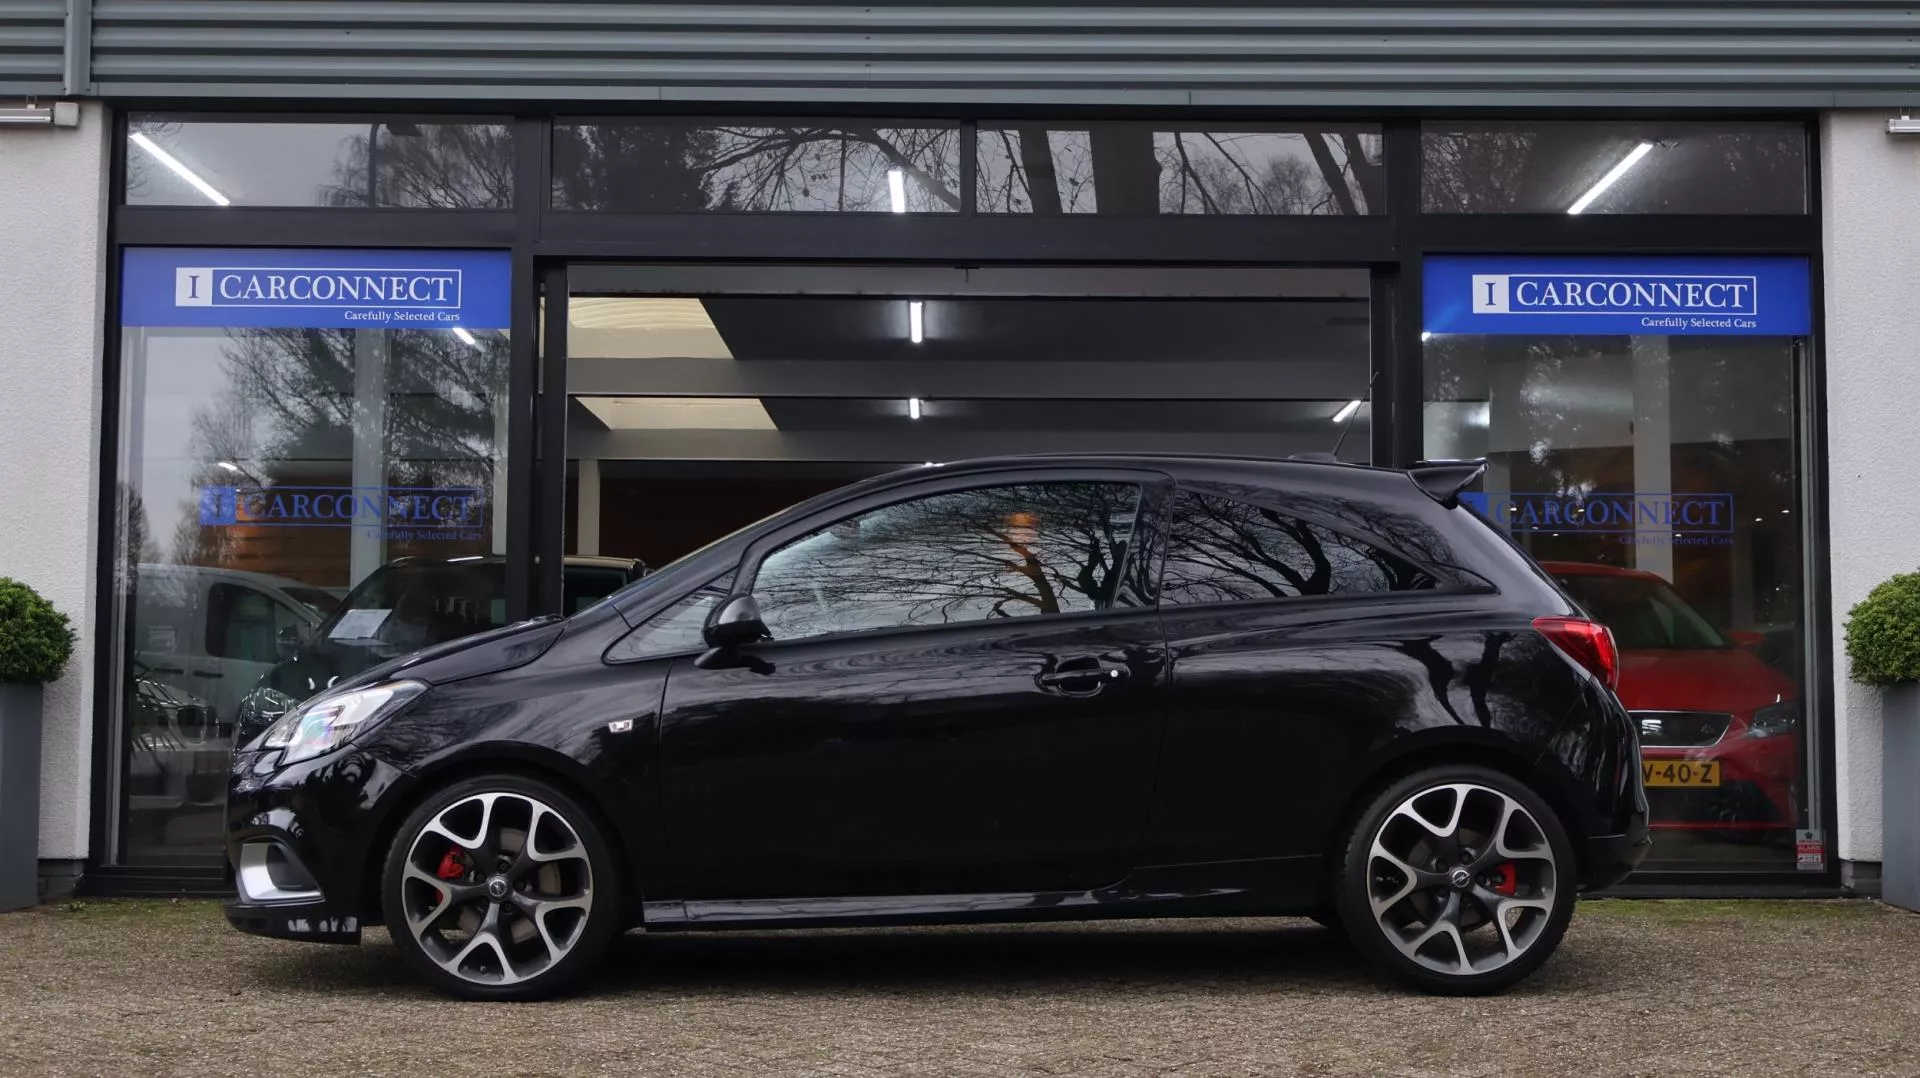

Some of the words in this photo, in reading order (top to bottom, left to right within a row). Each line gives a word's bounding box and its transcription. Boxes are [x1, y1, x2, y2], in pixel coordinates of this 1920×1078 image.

[219, 274, 453, 301] CARCONNECT
[1516, 281, 1748, 308] CARCONNECT
[344, 310, 391, 323] Carefully
[394, 311, 435, 321] Selected
[437, 312, 460, 321] Cars
[1641, 317, 1688, 330] Carefully
[1690, 317, 1731, 328] Selected
[1733, 318, 1757, 328] Cars
[247, 493, 470, 521] CARCONNECT
[1495, 500, 1725, 526] CARCONNECT
